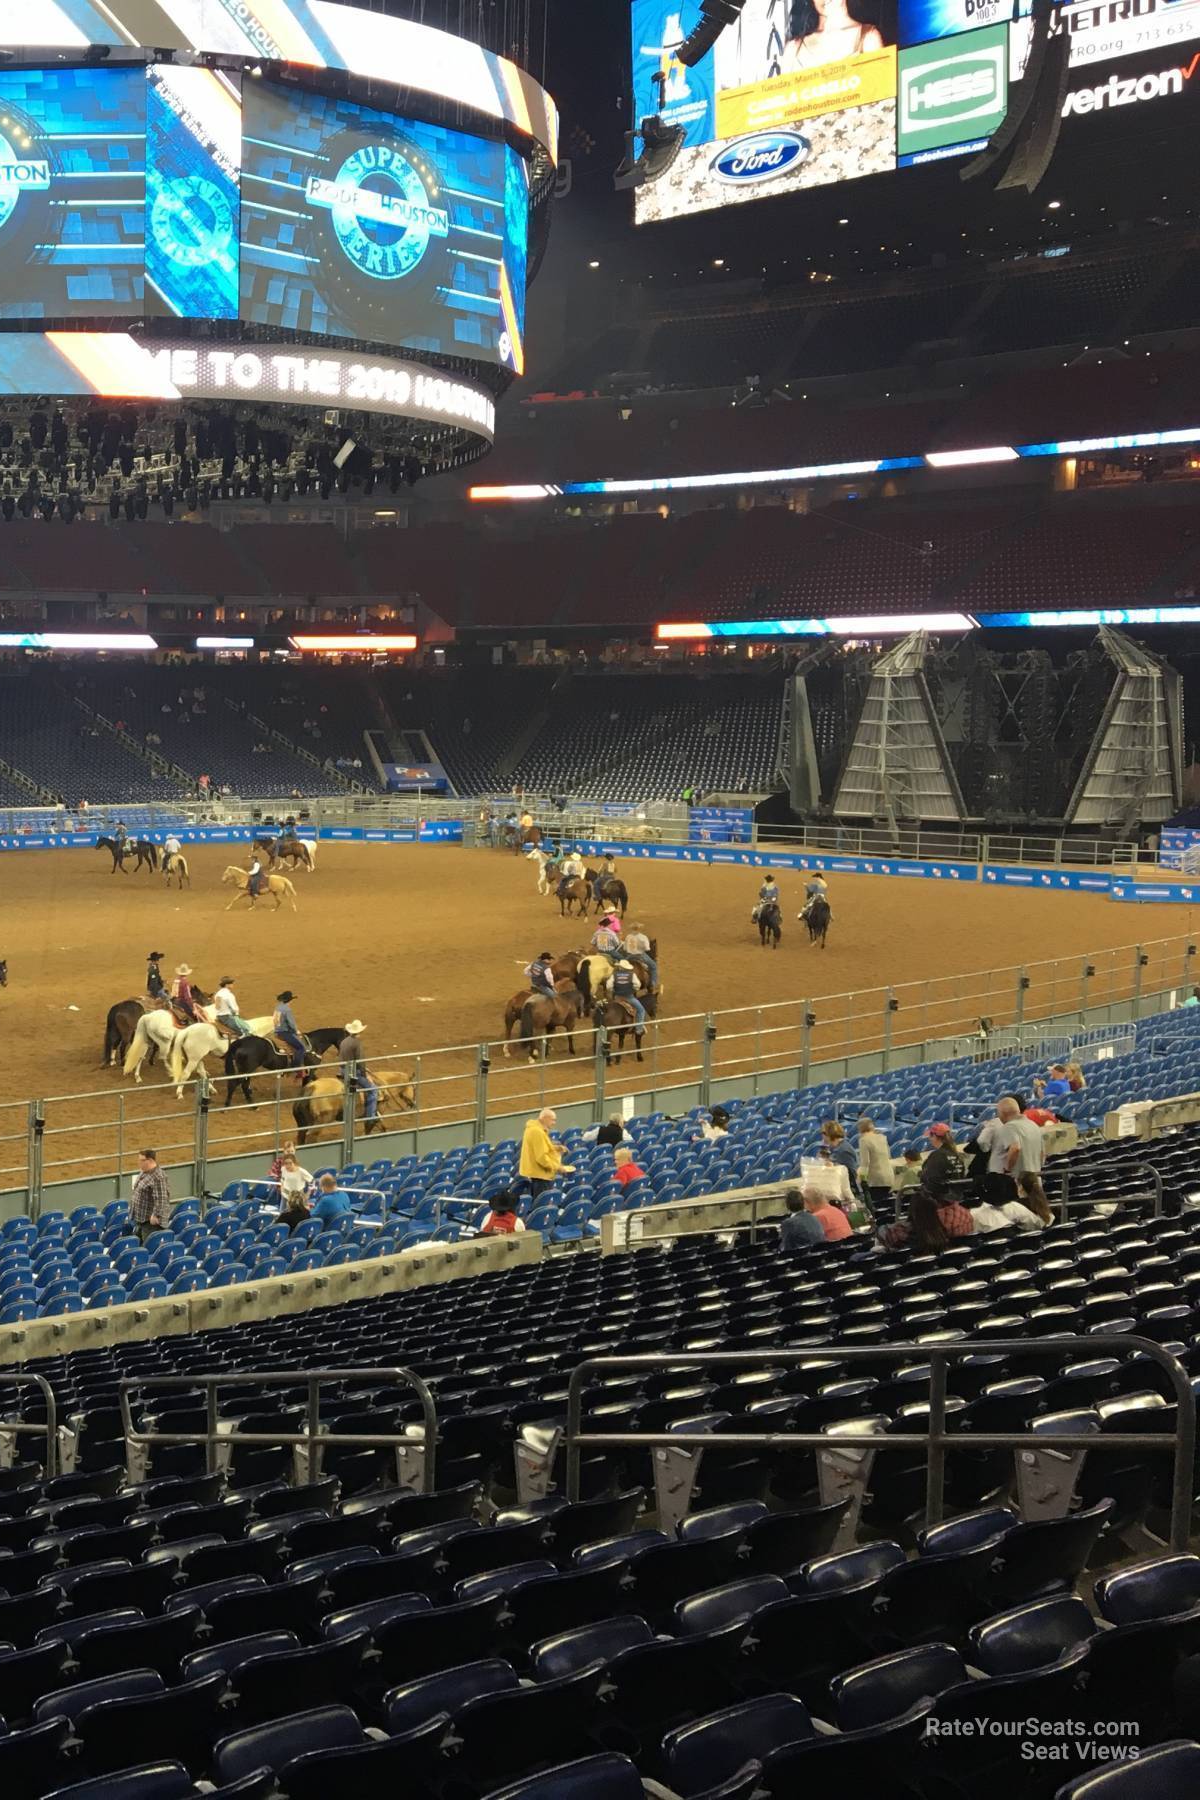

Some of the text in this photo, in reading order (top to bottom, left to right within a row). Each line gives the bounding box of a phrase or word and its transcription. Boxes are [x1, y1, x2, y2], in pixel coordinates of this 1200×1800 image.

[1071, 0, 1157, 33] ETRO
[1136, 28, 1160, 44] 713
[1167, 21, 1193, 36] 635
[909, 67, 995, 112] HESS
[345, 145, 424, 190] SUPER
[732, 147, 784, 175] Ford
[208, 352, 262, 388] TO
[272, 356, 341, 395] THE
[347, 364, 411, 405] 2019
